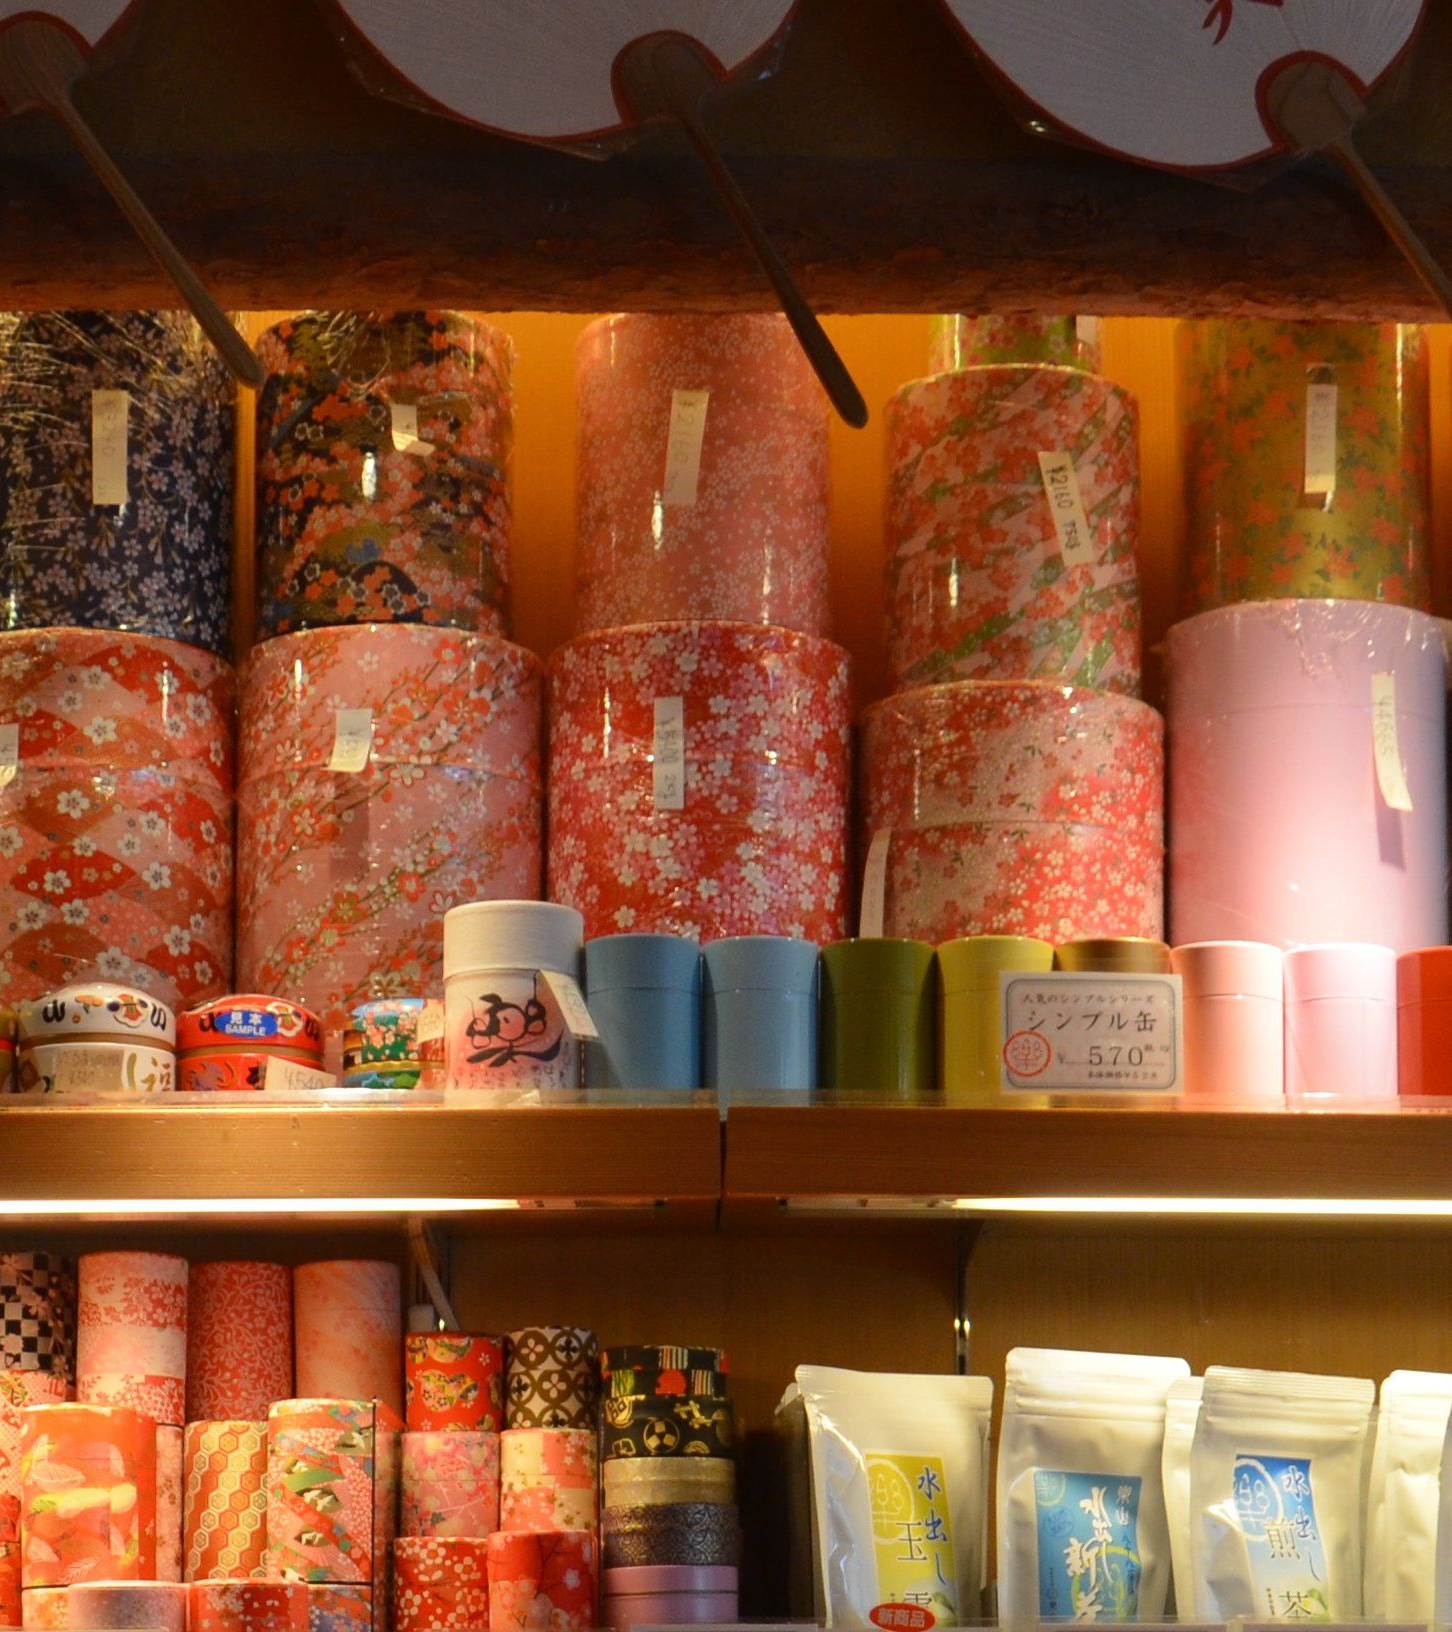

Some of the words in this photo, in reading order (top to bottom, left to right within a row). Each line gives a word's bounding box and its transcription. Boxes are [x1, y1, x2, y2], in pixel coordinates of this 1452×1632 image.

[229, 1011, 263, 1024] 見本
[1028, 1010, 1157, 1033] シンプル缶
[224, 1023, 267, 1036] SAMPLE
[1089, 1046, 1143, 1066] 570
[916, 1466, 949, 1585] 水出し
[1283, 1466, 1324, 1581] 水出し
[1265, 1518, 1315, 1617] 煎茶
